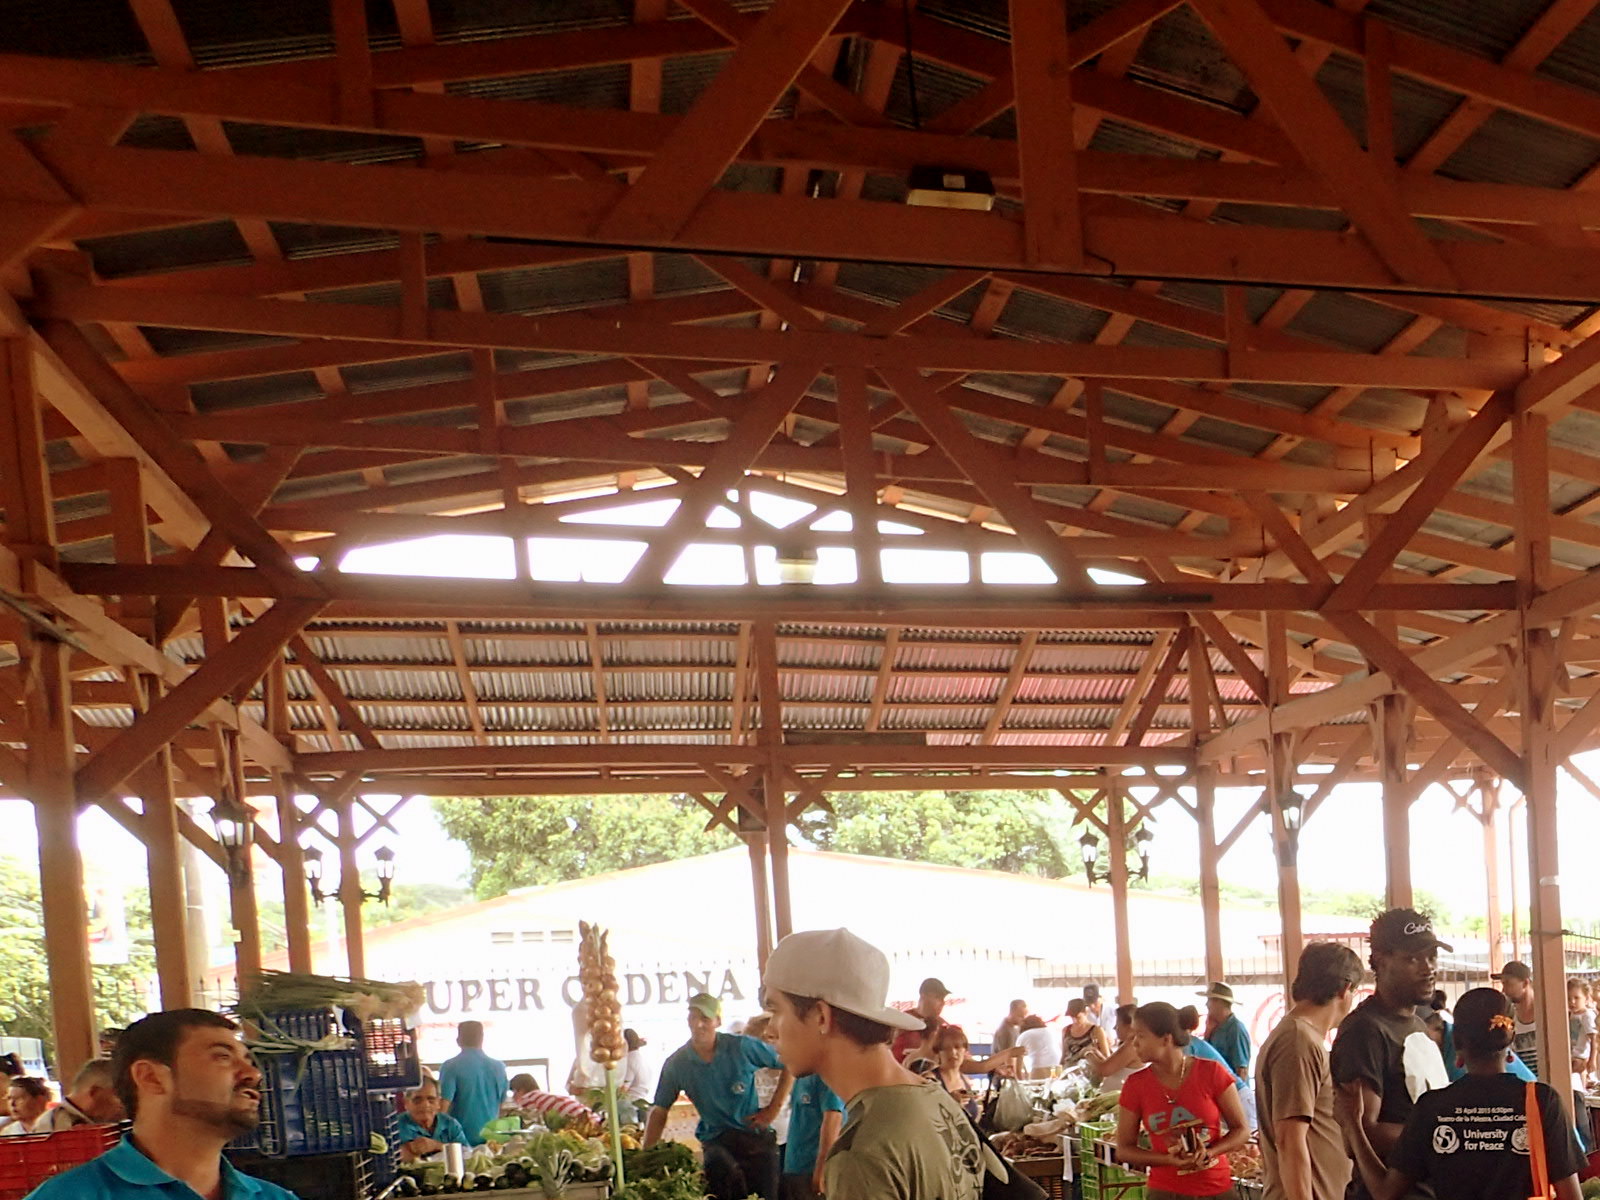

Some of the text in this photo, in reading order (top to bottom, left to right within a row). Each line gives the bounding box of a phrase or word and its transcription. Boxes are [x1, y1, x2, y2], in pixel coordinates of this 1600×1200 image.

[424, 968, 745, 1015] UPER CDENA
[1463, 1129, 1508, 1141] University
[1464, 1141, 1505, 1150] for Peace
